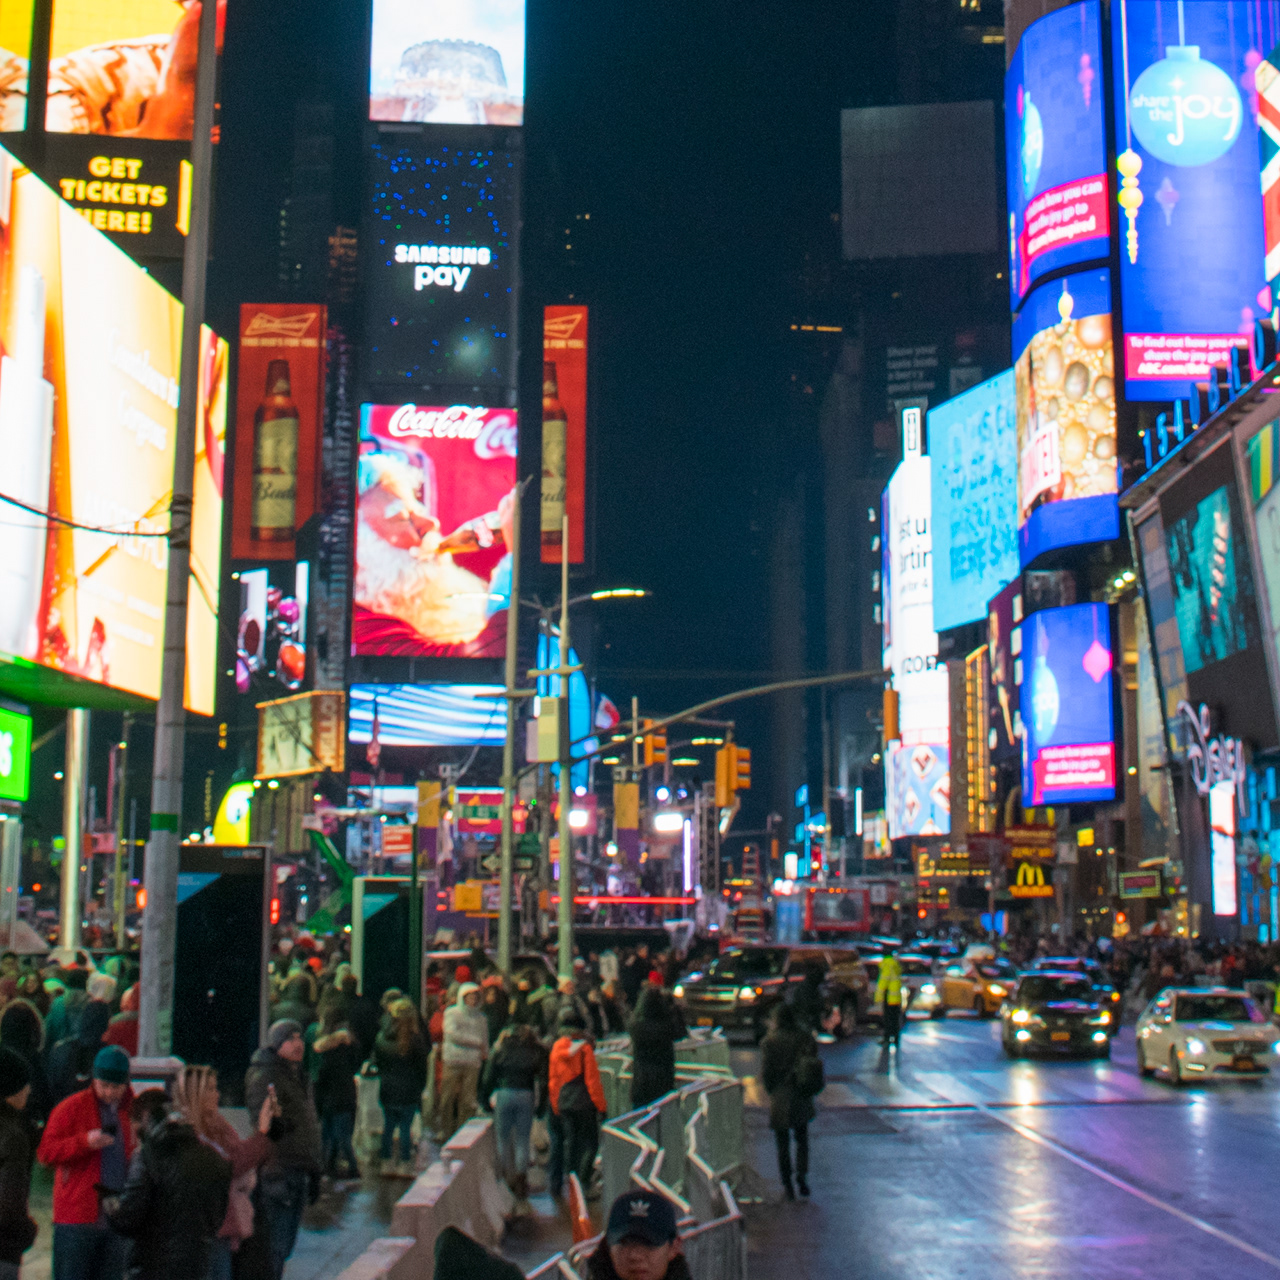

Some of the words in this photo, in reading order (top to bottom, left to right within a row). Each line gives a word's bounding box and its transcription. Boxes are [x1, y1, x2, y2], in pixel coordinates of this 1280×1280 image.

[1132, 94, 1169, 108] share
[1149, 109, 1173, 122] the
[1167, 93, 1239, 147] joy
[88, 156, 142, 179] GET
[59, 178, 168, 207] TICKETS
[394, 244, 491, 265] SAMSUNG
[414, 264, 471, 292] pay
[1130, 337, 1142, 347] To
[1143, 336, 1165, 347] find
[1166, 337, 1184, 347] out
[1185, 336, 1207, 347] how
[1208, 338, 1227, 349] you
[1144, 349, 1171, 361] share
[1172, 350, 1189, 361] the
[1190, 350, 1206, 364] joy
[1207, 352, 1220, 364] go
